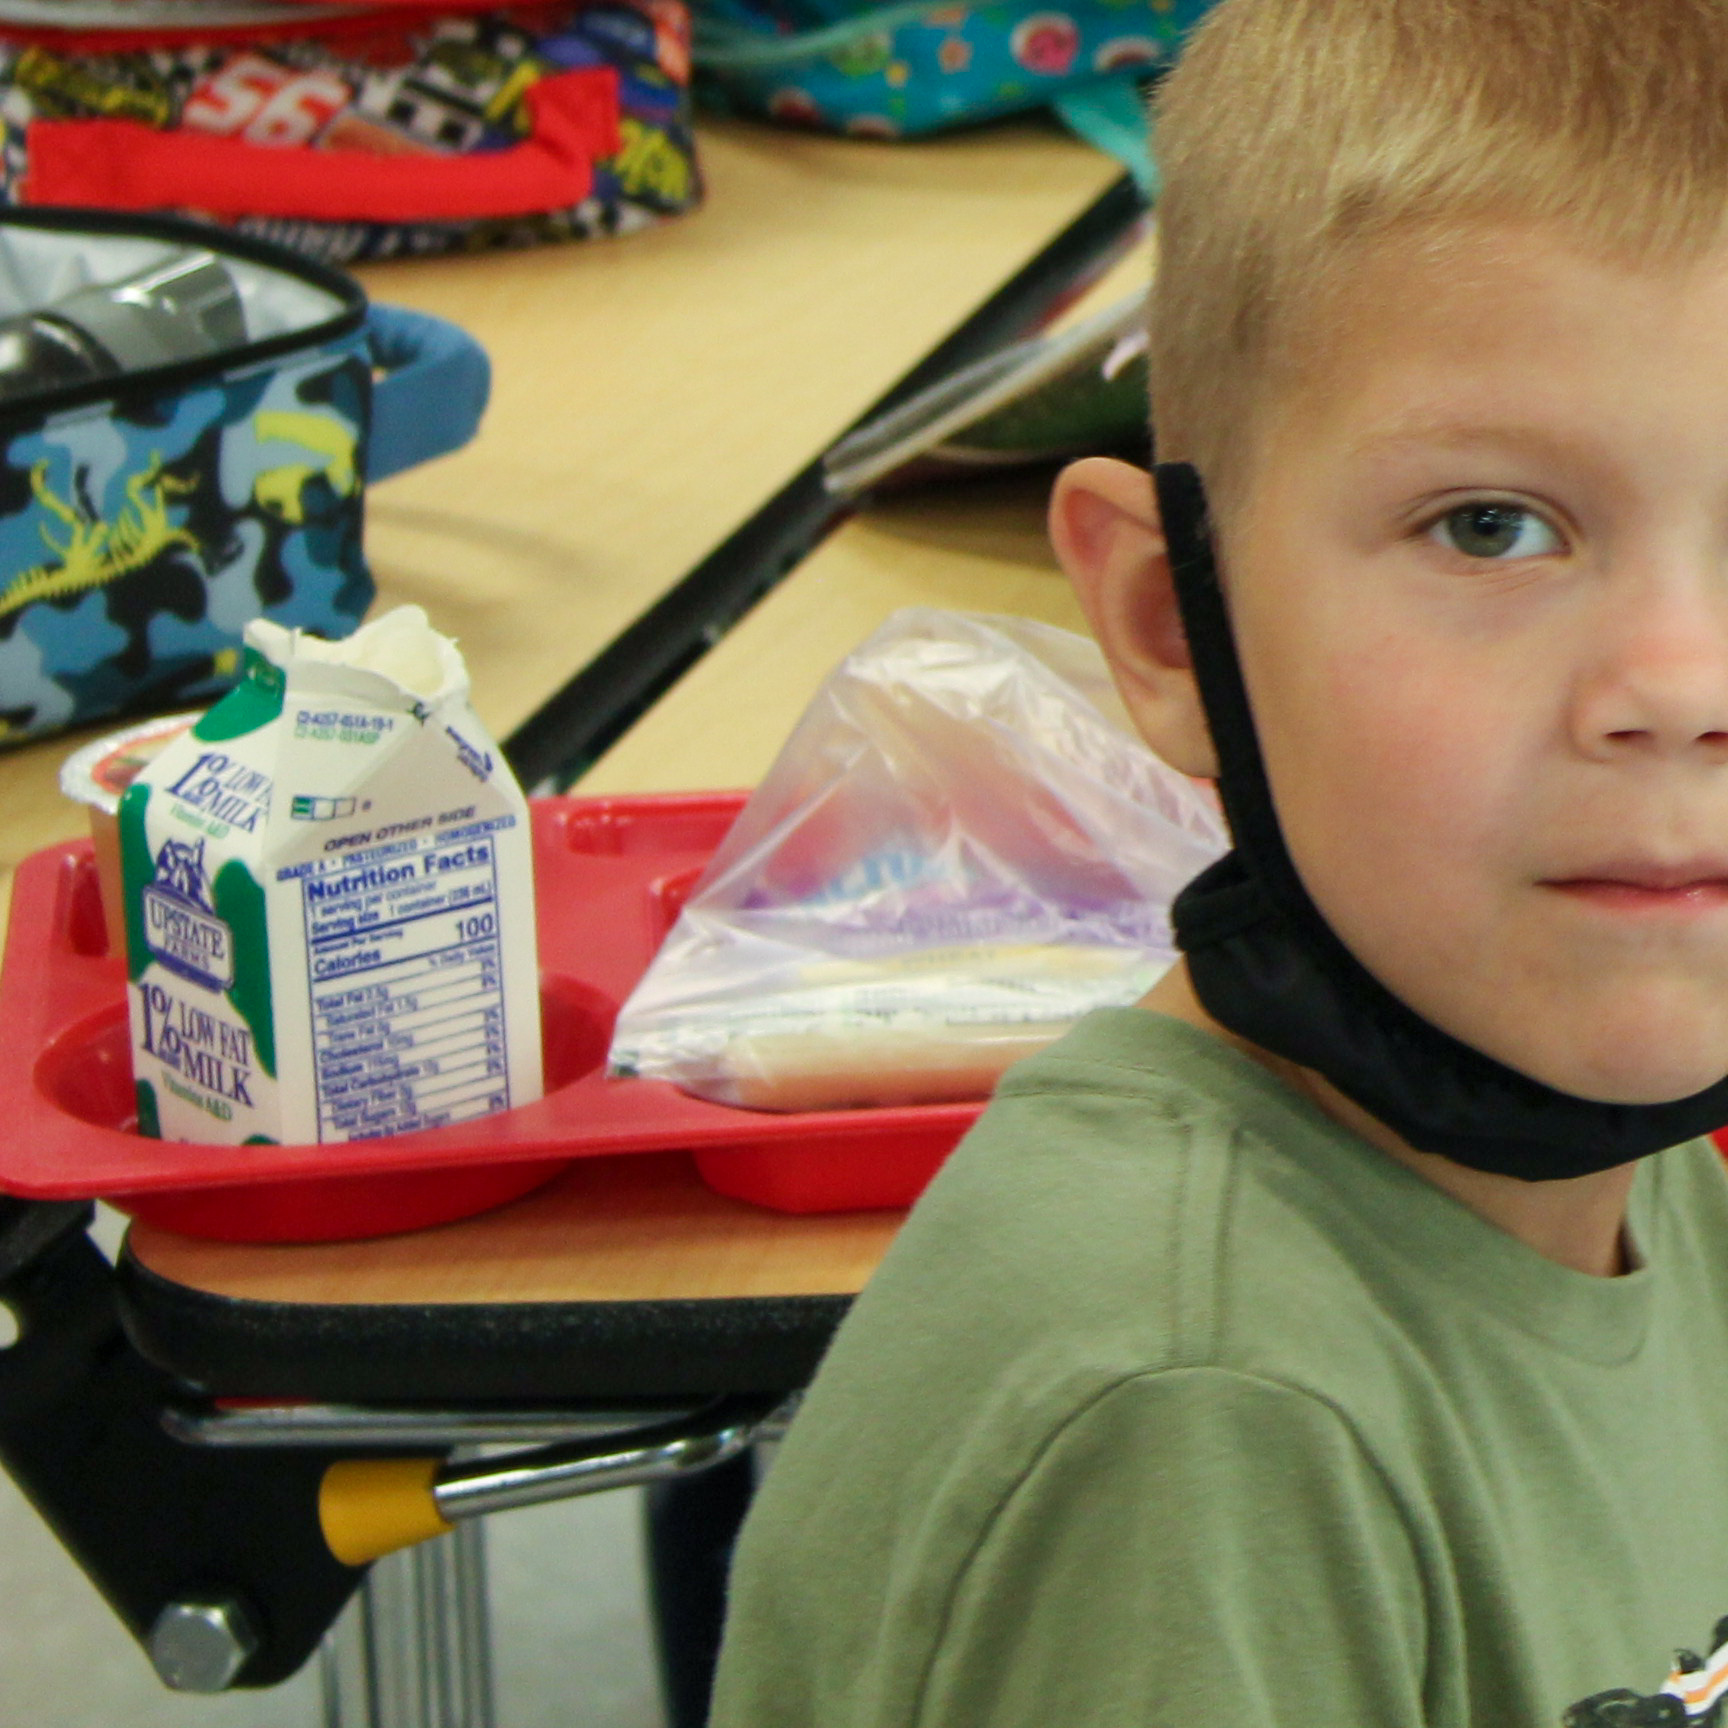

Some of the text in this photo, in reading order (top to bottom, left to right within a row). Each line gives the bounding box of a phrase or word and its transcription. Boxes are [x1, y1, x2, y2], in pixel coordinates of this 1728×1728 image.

[323, 805, 477, 852] OPEN OTHER SIDE
[307, 844, 490, 902] Nutrition Facts
[151, 896, 224, 960] UPSTATE
[313, 913, 494, 974] Calories 100
[139, 983, 182, 1055] 1%
[180, 1000, 215, 1051] LOW
[216, 1021, 252, 1067] FAT
[179, 1039, 255, 1109] MILK
